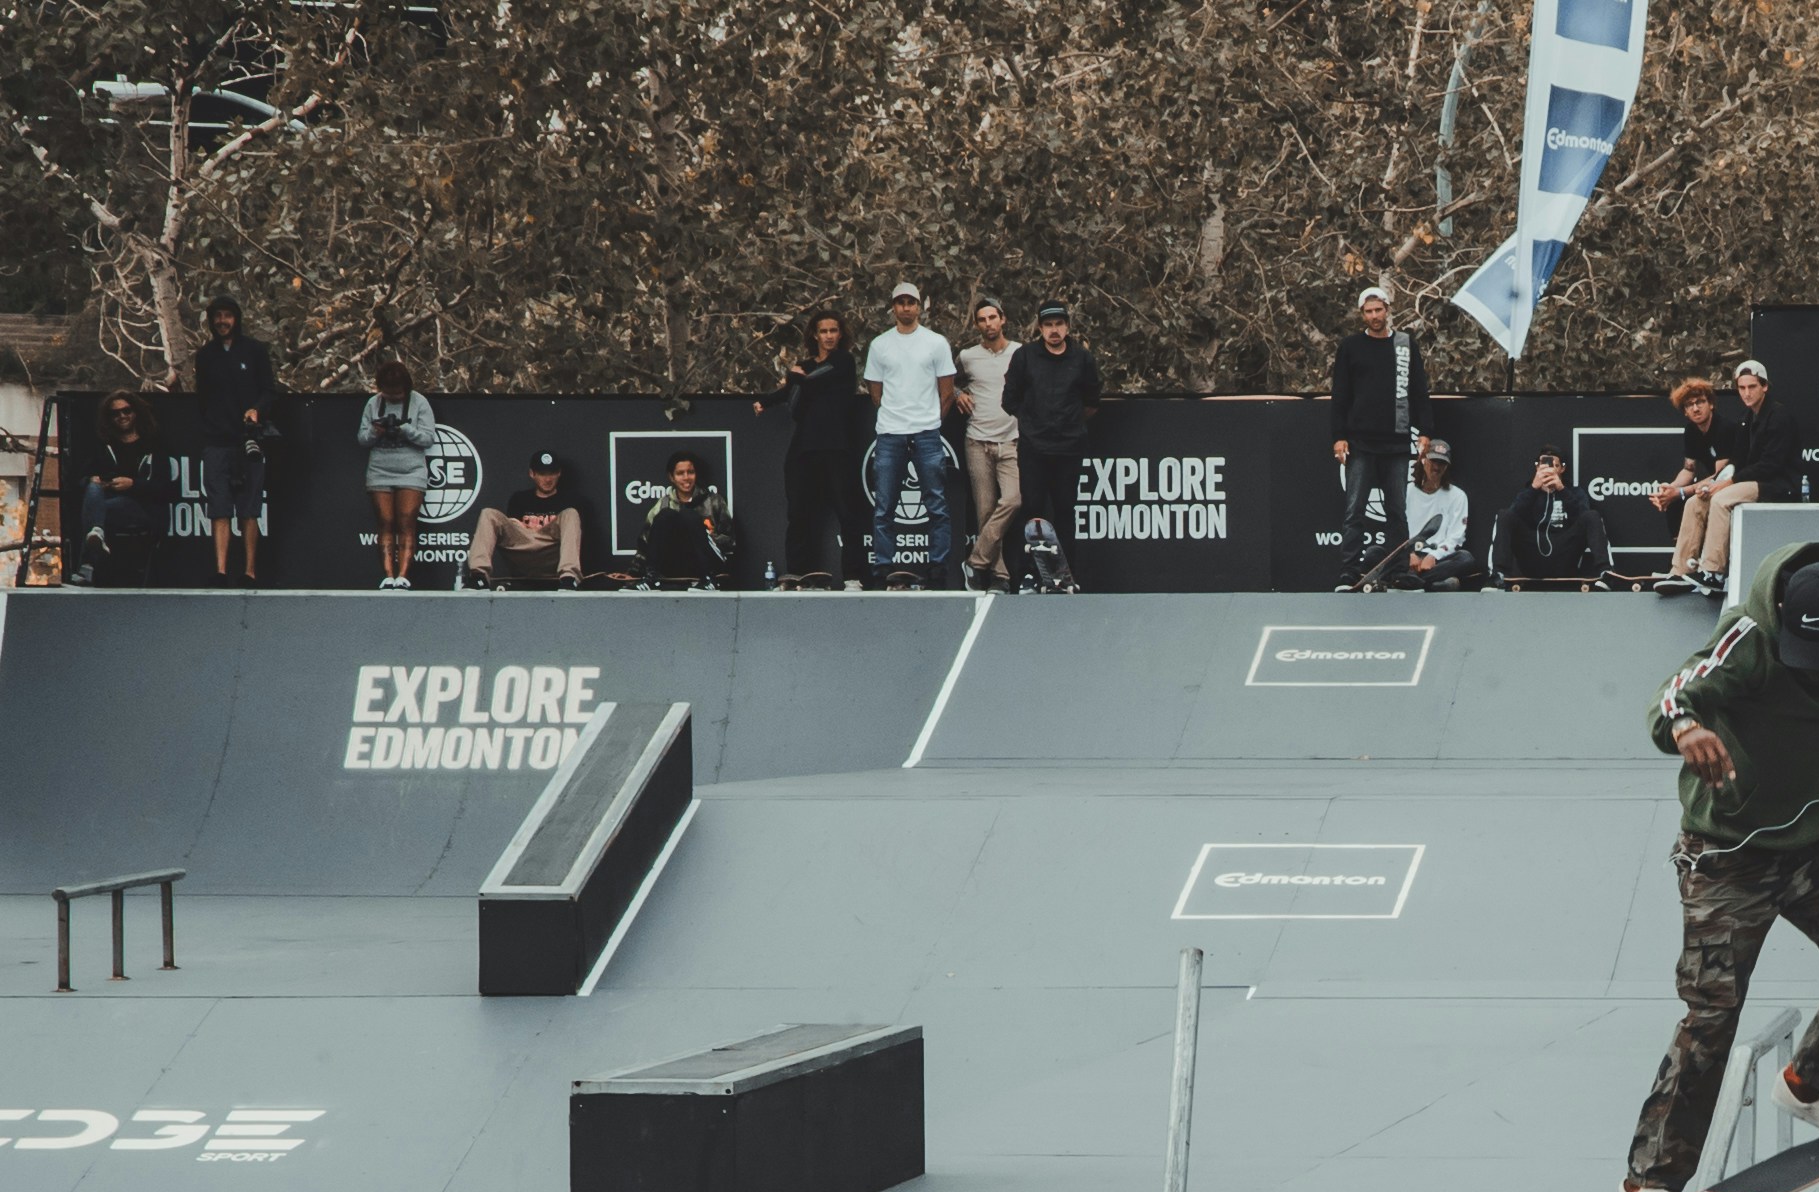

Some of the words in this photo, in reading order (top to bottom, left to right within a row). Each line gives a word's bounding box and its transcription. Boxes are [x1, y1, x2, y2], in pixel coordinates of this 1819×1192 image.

[1547, 128, 1614, 155] Edmonton
[1395, 345, 1410, 399] SUPRA
[1077, 457, 1226, 501] EXPLORE
[1588, 477, 1671, 501] Edmont
[1074, 503, 1227, 540] EDMONTON
[418, 532, 470, 546] SERIES
[896, 534, 929, 547] SERI
[1275, 649, 1406, 662] Edmonton
[353, 666, 601, 723] EXPLORE
[1214, 872, 1386, 888] Edmonton
[196, 1153, 287, 1162] SPORT
